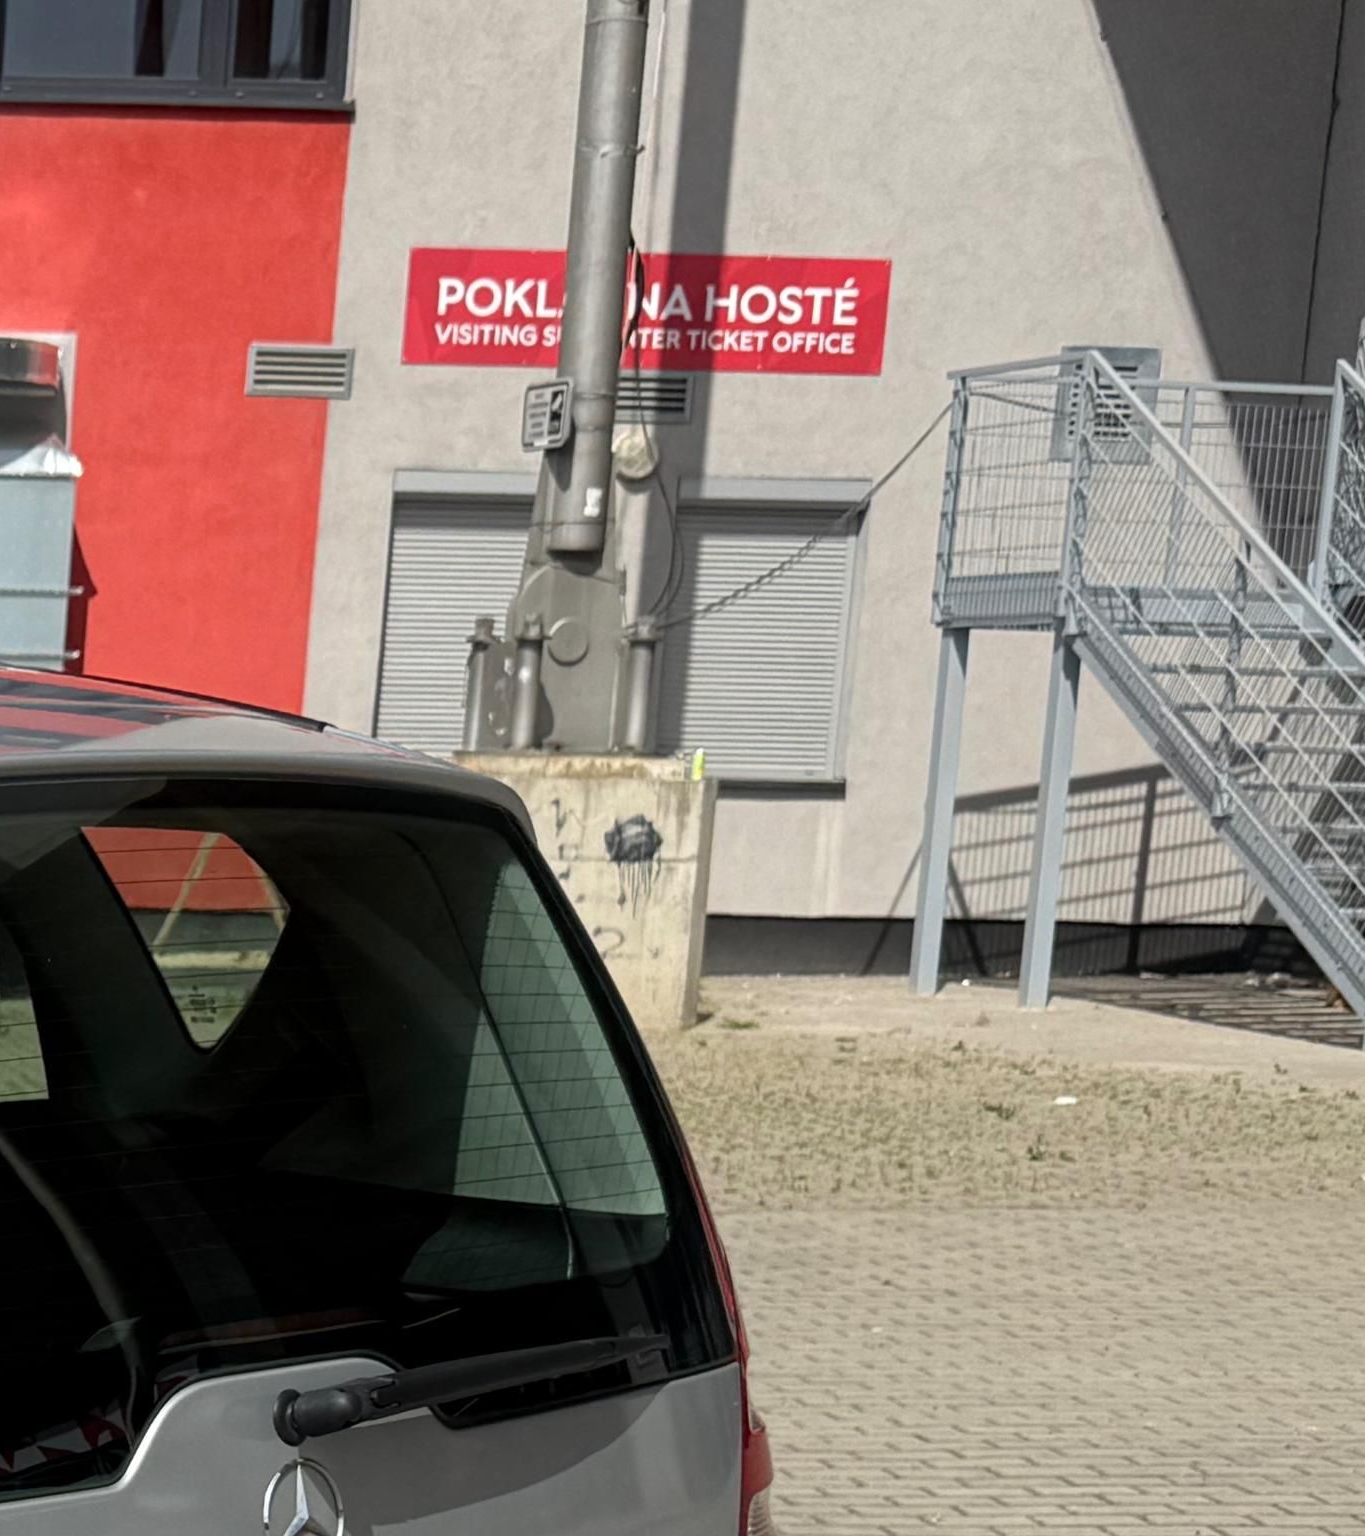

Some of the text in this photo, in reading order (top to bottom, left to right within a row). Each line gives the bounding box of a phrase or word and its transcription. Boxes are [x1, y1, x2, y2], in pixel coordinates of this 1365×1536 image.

[436, 277, 860, 326] POKLNA HOSTÉ
[434, 323, 538, 347] VISITING
[687, 328, 769, 352] TICKET
[771, 331, 856, 354] OFFICE
